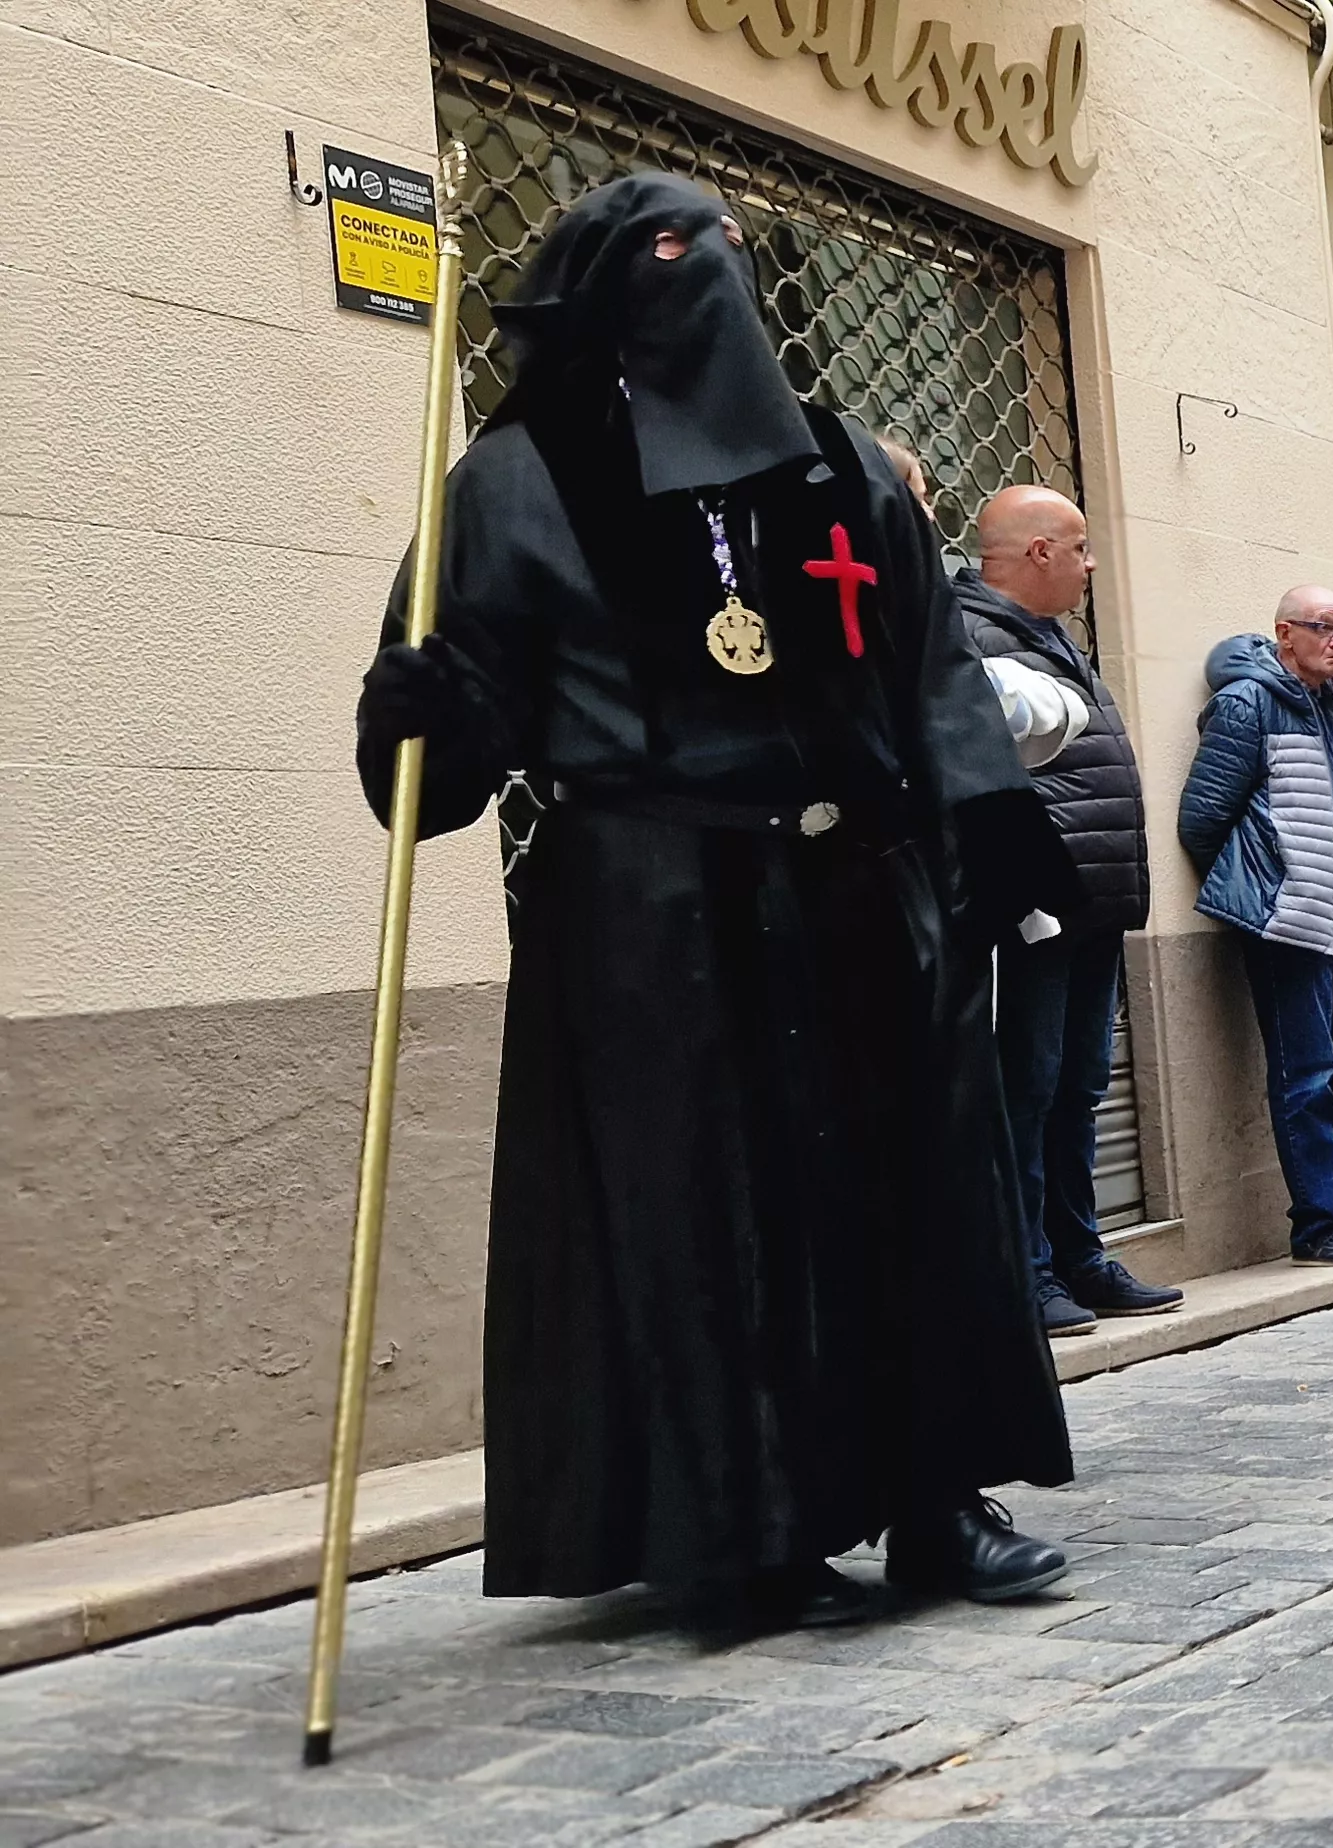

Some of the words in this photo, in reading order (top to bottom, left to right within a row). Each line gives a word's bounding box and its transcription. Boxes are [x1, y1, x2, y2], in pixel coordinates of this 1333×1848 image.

[388, 176, 429, 195] MOVISTAR
[389, 186, 433, 206] PROSEGUR
[341, 214, 429, 249] CONECTADA
[342, 230, 361, 243] CON
[363, 236, 390, 249] AVISO
[398, 246, 430, 260] POLICÍA
